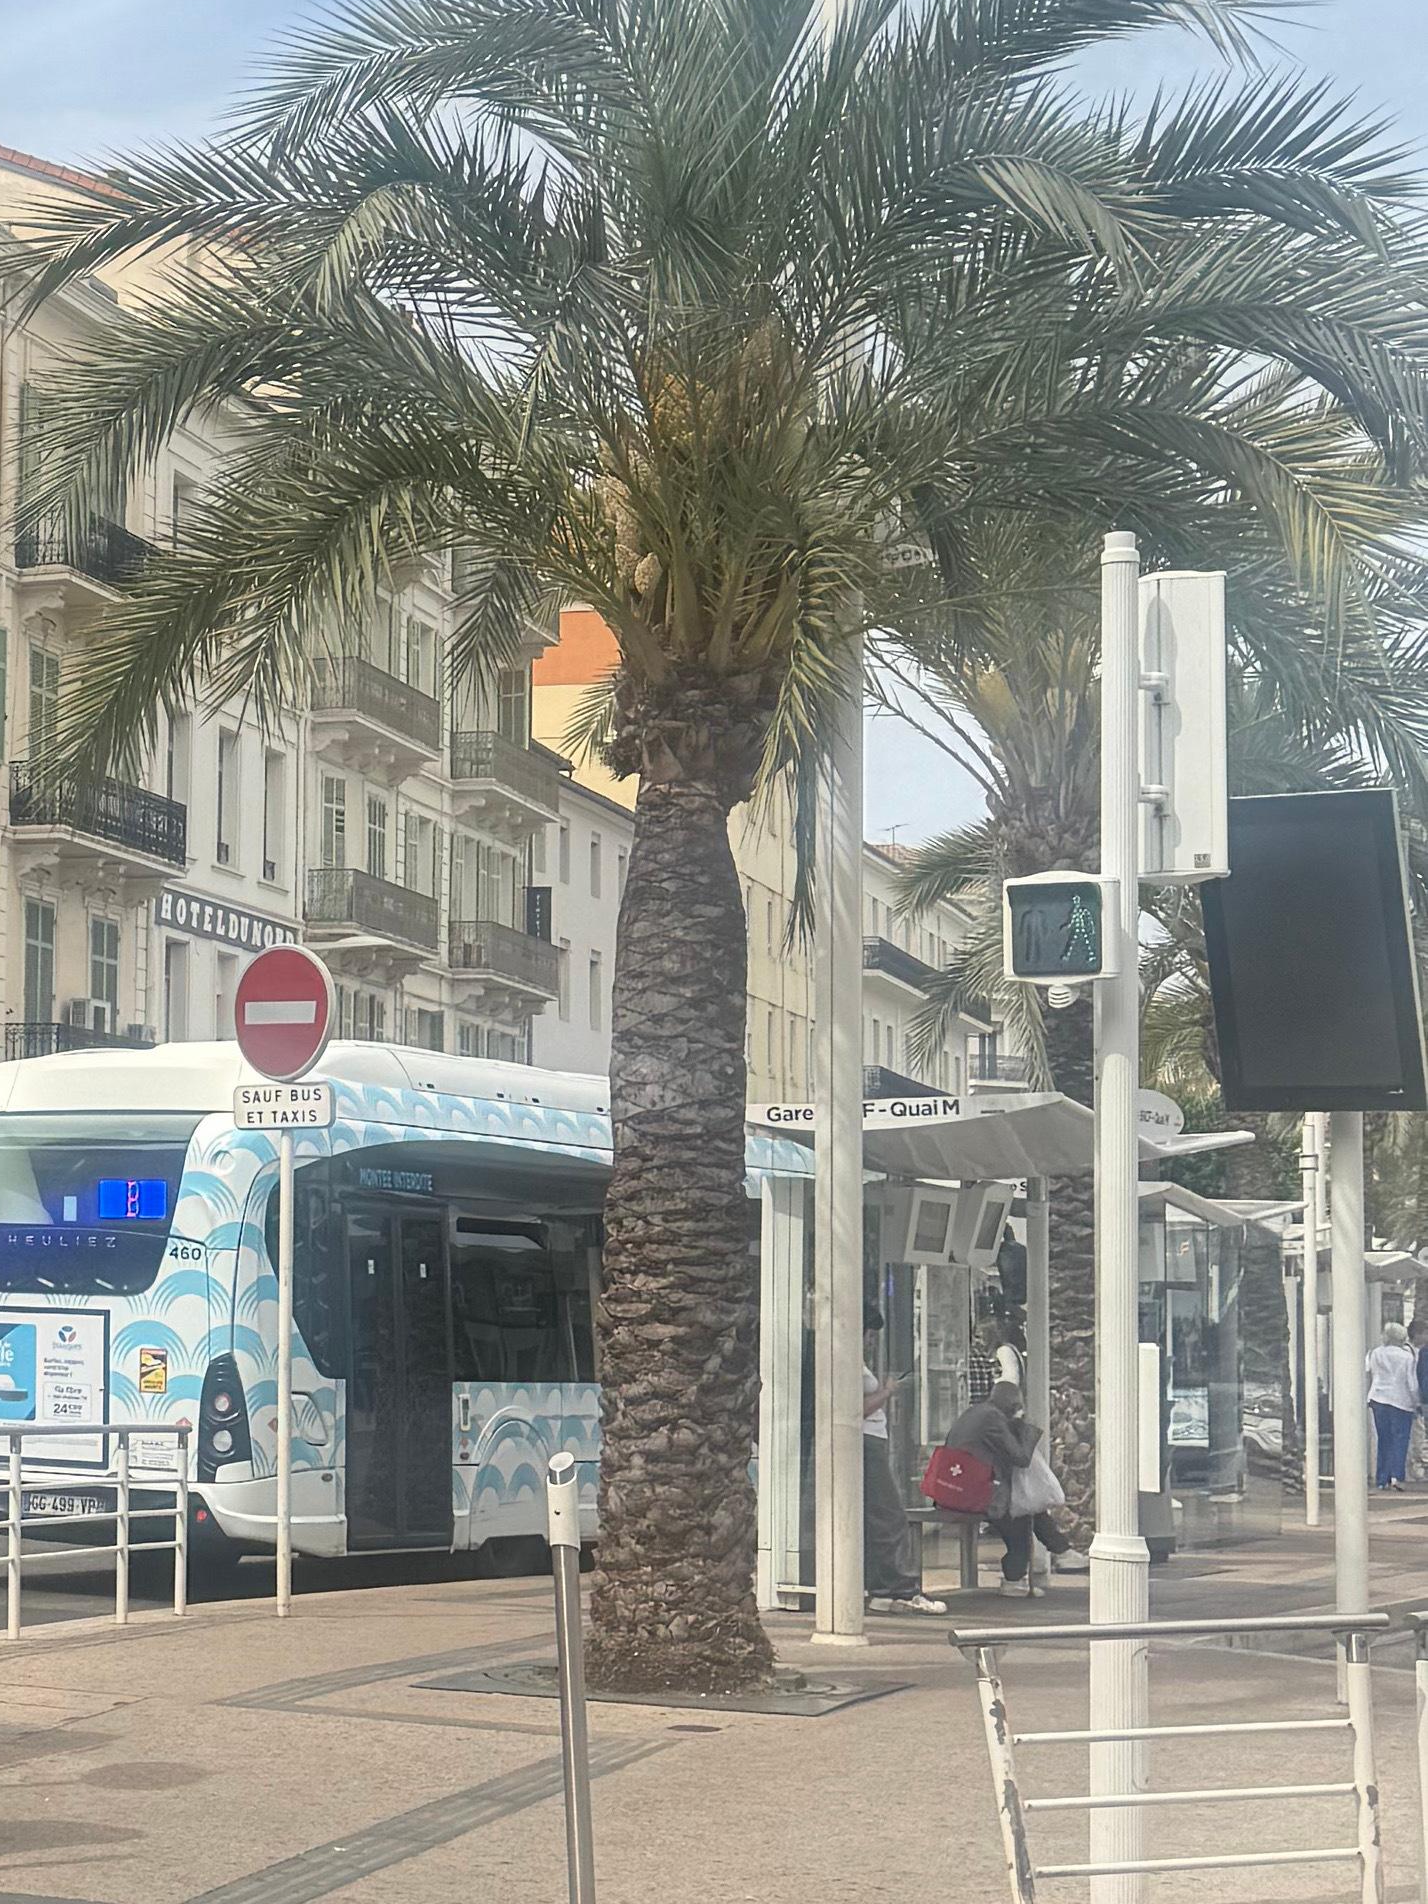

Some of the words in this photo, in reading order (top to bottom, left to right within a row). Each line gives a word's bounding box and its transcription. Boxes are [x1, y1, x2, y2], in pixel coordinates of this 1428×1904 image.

[160, 892, 225, 936] HOTEL
[228, 913, 249, 943] DU
[242, 1089, 283, 1104] SAUF
[290, 1088, 322, 1102] BUS
[766, 1105, 814, 1123] Gare
[891, 1099, 938, 1117] Quai
[942, 1099, 960, 1116] M
[247, 1111, 263, 1124] ET
[271, 1109, 317, 1123] TAXIS
[8, 1234, 117, 1248] HEULIEZ
[169, 1246, 202, 1261] 460
[54, 1403, 67, 1414] 24
